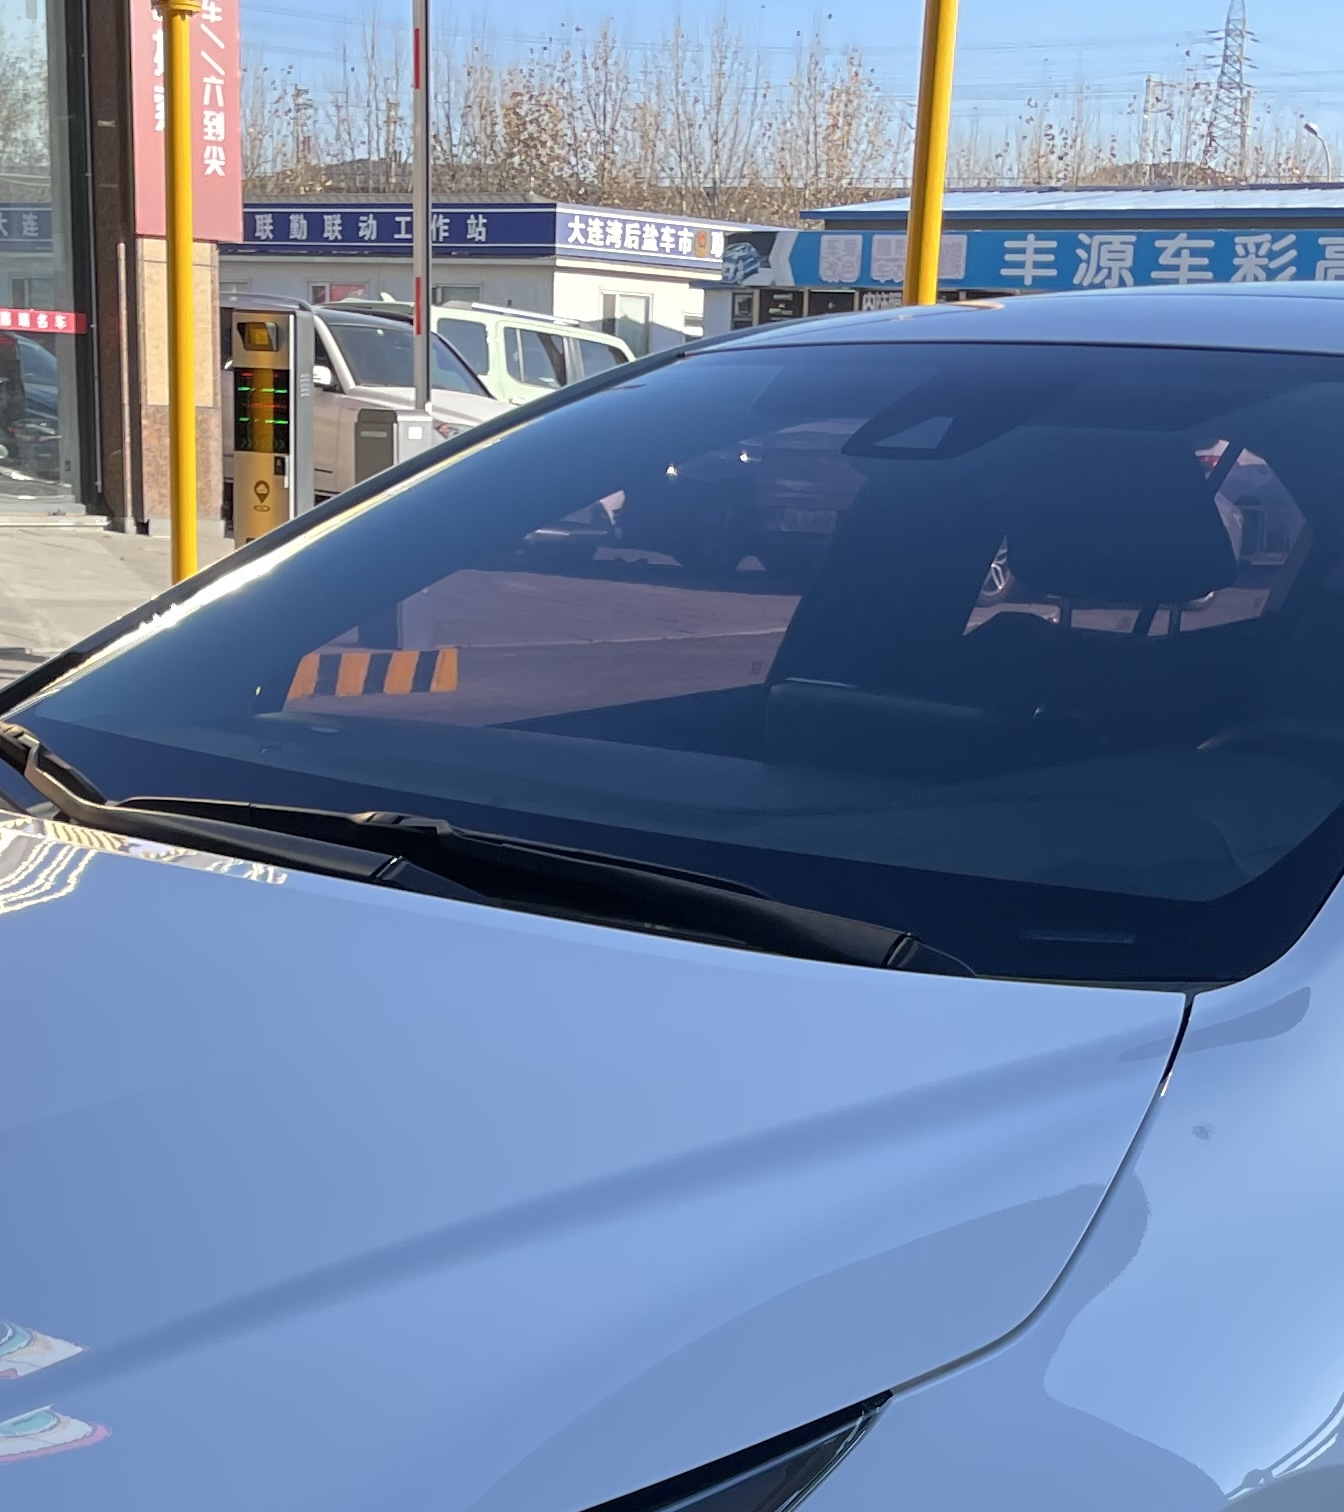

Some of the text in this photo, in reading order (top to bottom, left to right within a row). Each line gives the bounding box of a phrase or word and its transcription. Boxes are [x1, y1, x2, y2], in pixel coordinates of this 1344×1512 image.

[254, 213, 487, 242] 联勤联动工作站
[567, 215, 695, 255] 大连湾后盐车市
